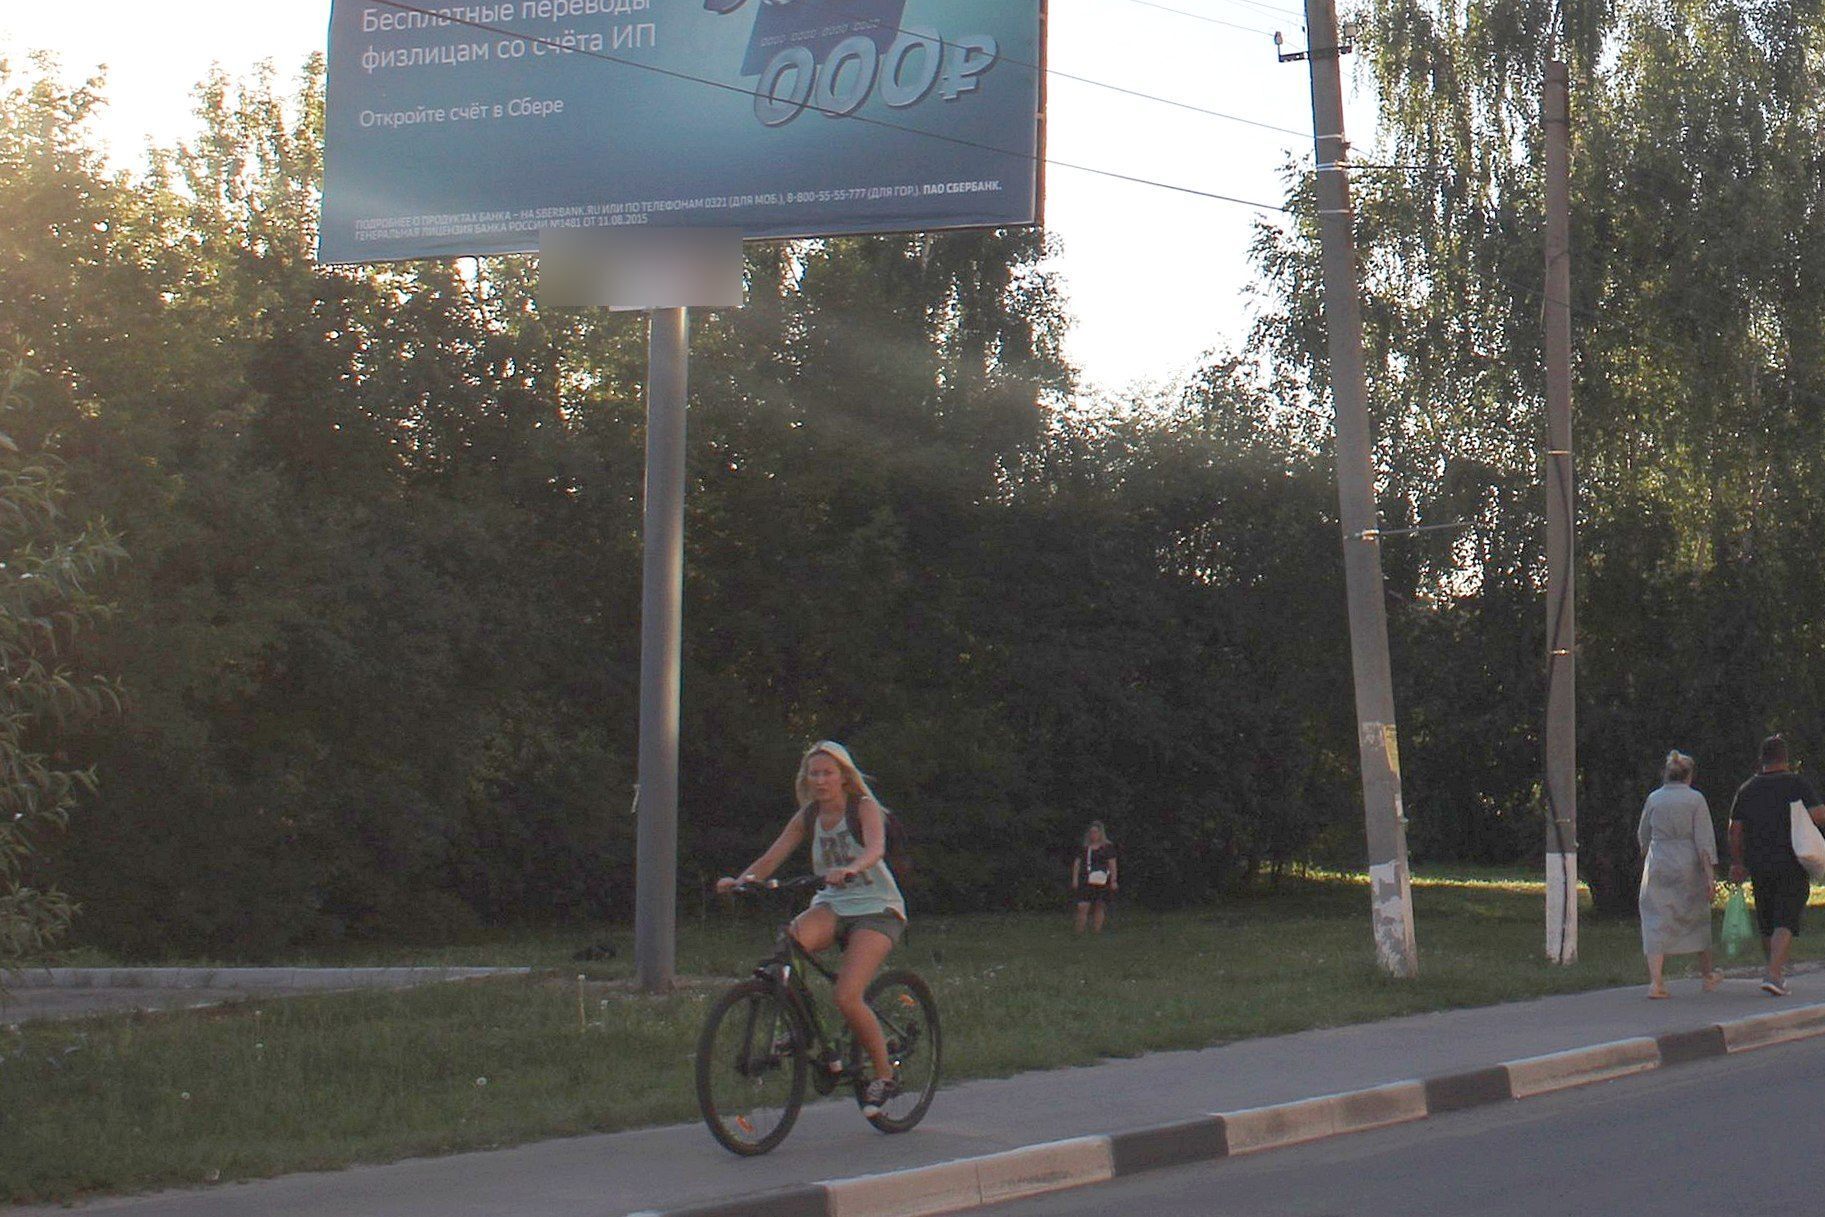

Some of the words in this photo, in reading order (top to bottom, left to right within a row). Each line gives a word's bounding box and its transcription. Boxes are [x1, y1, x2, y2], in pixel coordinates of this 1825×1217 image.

[363, 2, 514, 32] Бесплатные
[361, 42, 489, 74] физлицам
[497, 38, 525, 59] со
[532, 30, 603, 55] счёта
[613, 23, 656, 50] ИП
[360, 106, 445, 128] Откройте
[450, 101, 488, 120] счёт
[494, 104, 503, 118] в
[508, 97, 564, 119] Сбере
[355, 215, 412, 230] ПОДРОБНЕЕ
[421, 213, 478, 227] ПРОДУКТАХ
[479, 211, 511, 222] БАНКА
[521, 209, 535, 219] НА
[536, 205, 600, 219] SBERBANK.RU
[602, 203, 624, 215] ИЛИ
[625, 202, 640, 213] ПО
[641, 199, 704, 212] ТЕЛЕФОНАМ
[705, 197, 727, 208] 0321
[729, 195, 753, 208] (ДЛЯ
[786, 188, 866, 204] 8-800-55-55-777
[867, 186, 892, 200] (ДЛЯ
[923, 183, 945, 196] ПАО
[946, 180, 1002, 194] СБЕРБАНК.
[355, 227, 419, 241] ГЕНЕРАЛЬНАЯ
[422, 225, 475, 238] ЛИЦЕНЗИЯ
[476, 222, 507, 234] БАНКА
[509, 219, 548, 232] РОССИИ
[548, 216, 581, 229] №1481
[583, 216, 596, 227] ОТ
[598, 213, 648, 227] 11.08.2015
